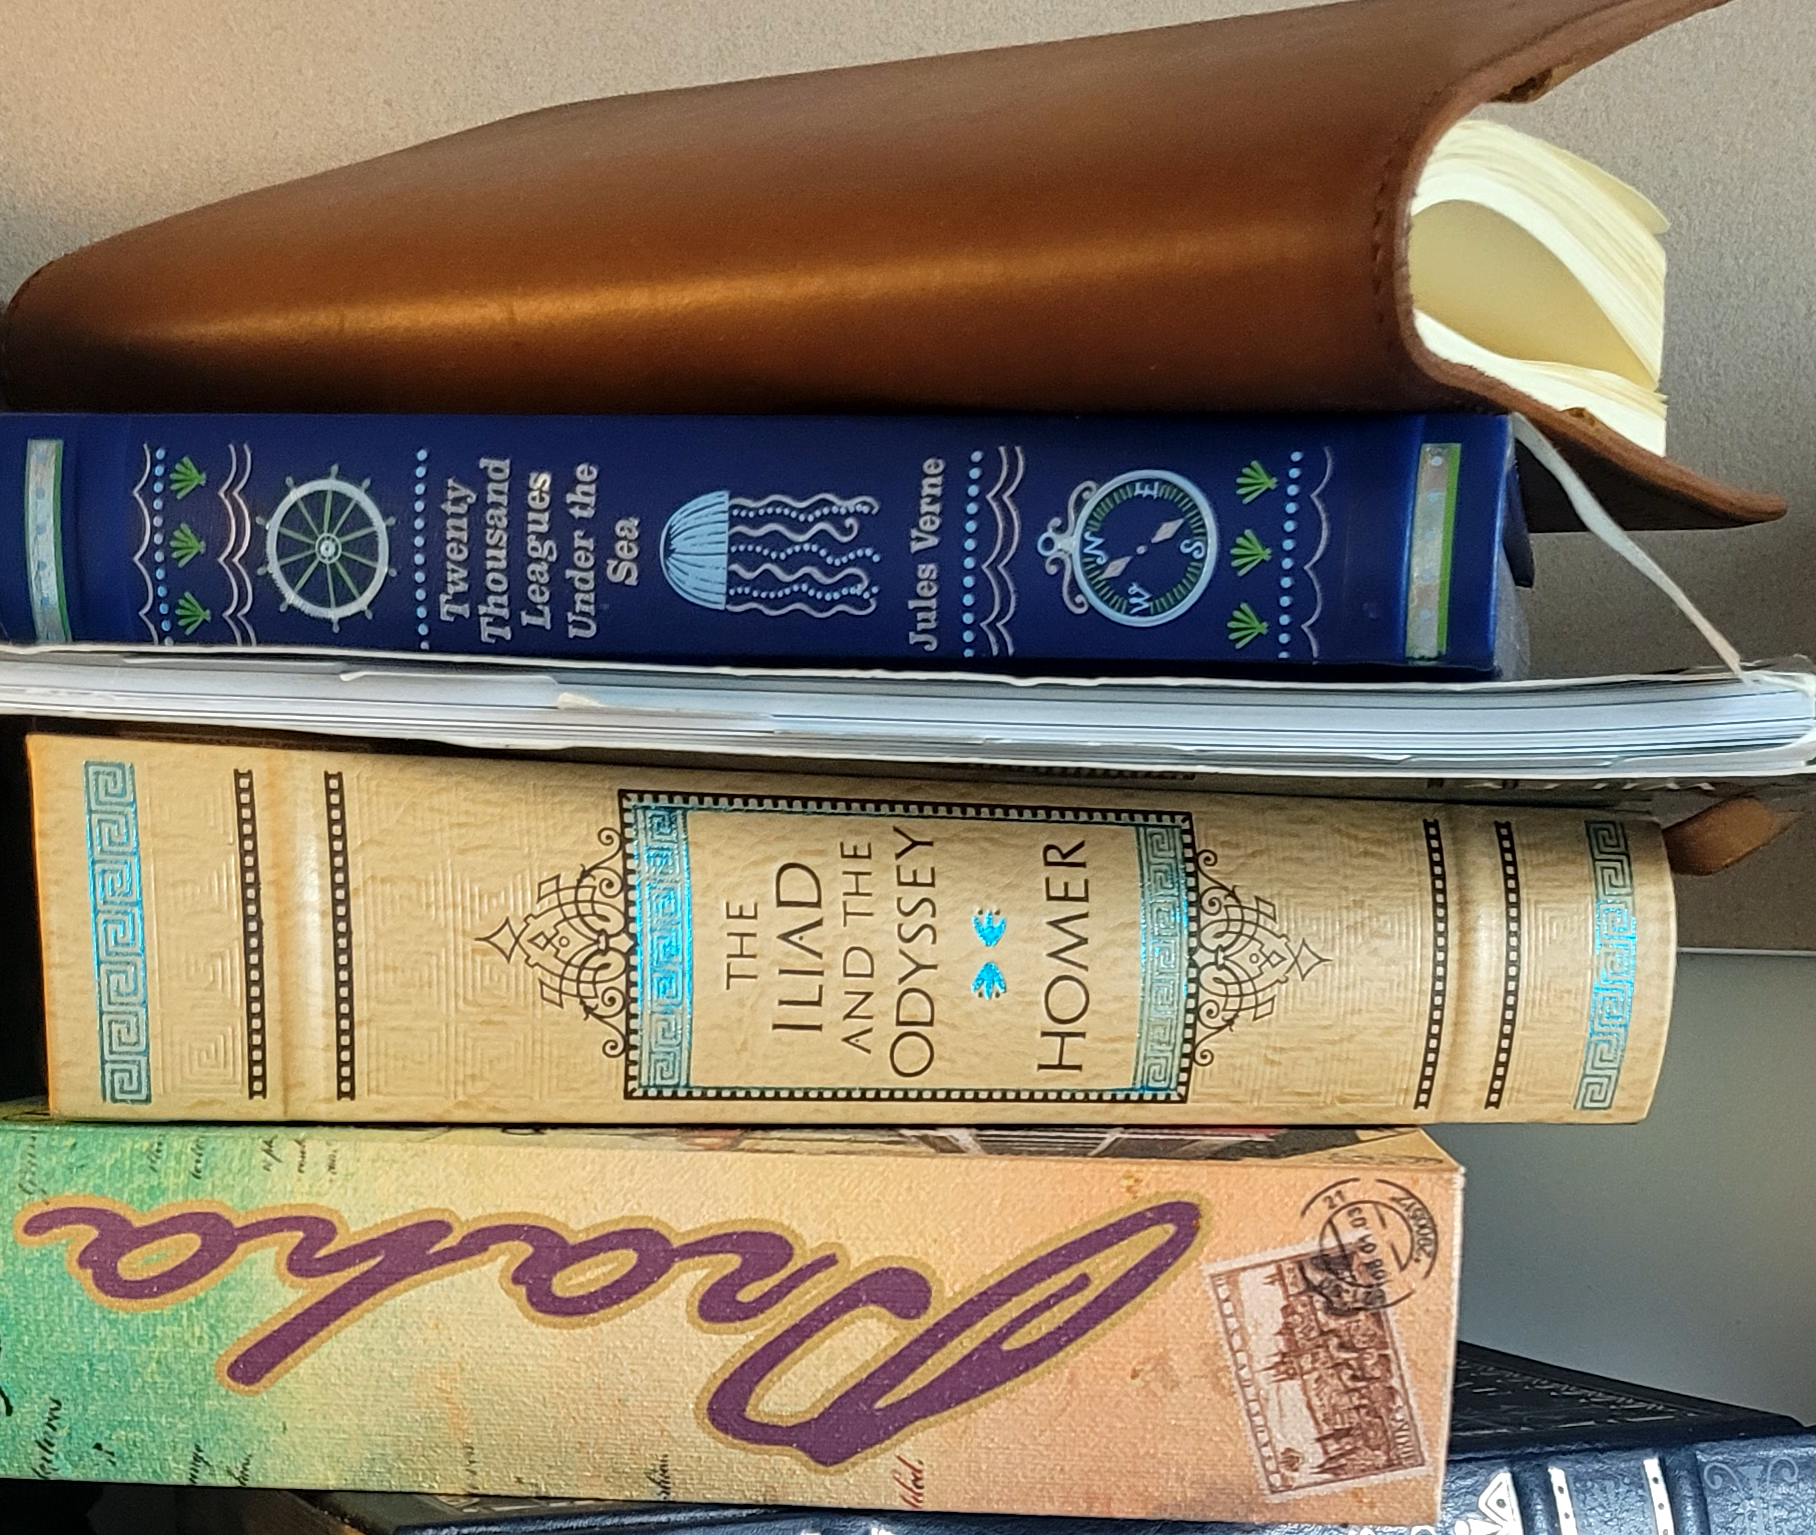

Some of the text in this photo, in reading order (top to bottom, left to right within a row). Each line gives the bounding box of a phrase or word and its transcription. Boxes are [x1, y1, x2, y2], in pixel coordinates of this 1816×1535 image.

[440, 478, 476, 622] Twenty
[480, 457, 512, 643] Thousand
[521, 470, 557, 630] Leagues
[568, 462, 598, 640] Under the
[607, 516, 640, 586] Sea
[910, 457, 946, 651] Jules Verne
[726, 901, 758, 990] THE
[772, 862, 824, 1031] ILIAD
[840, 841, 875, 1055] AND THE
[889, 825, 937, 1078] ODYSSEY
[1037, 840, 1089, 1072] HOMER
[16, 1193, 1209, 1467] Praha
